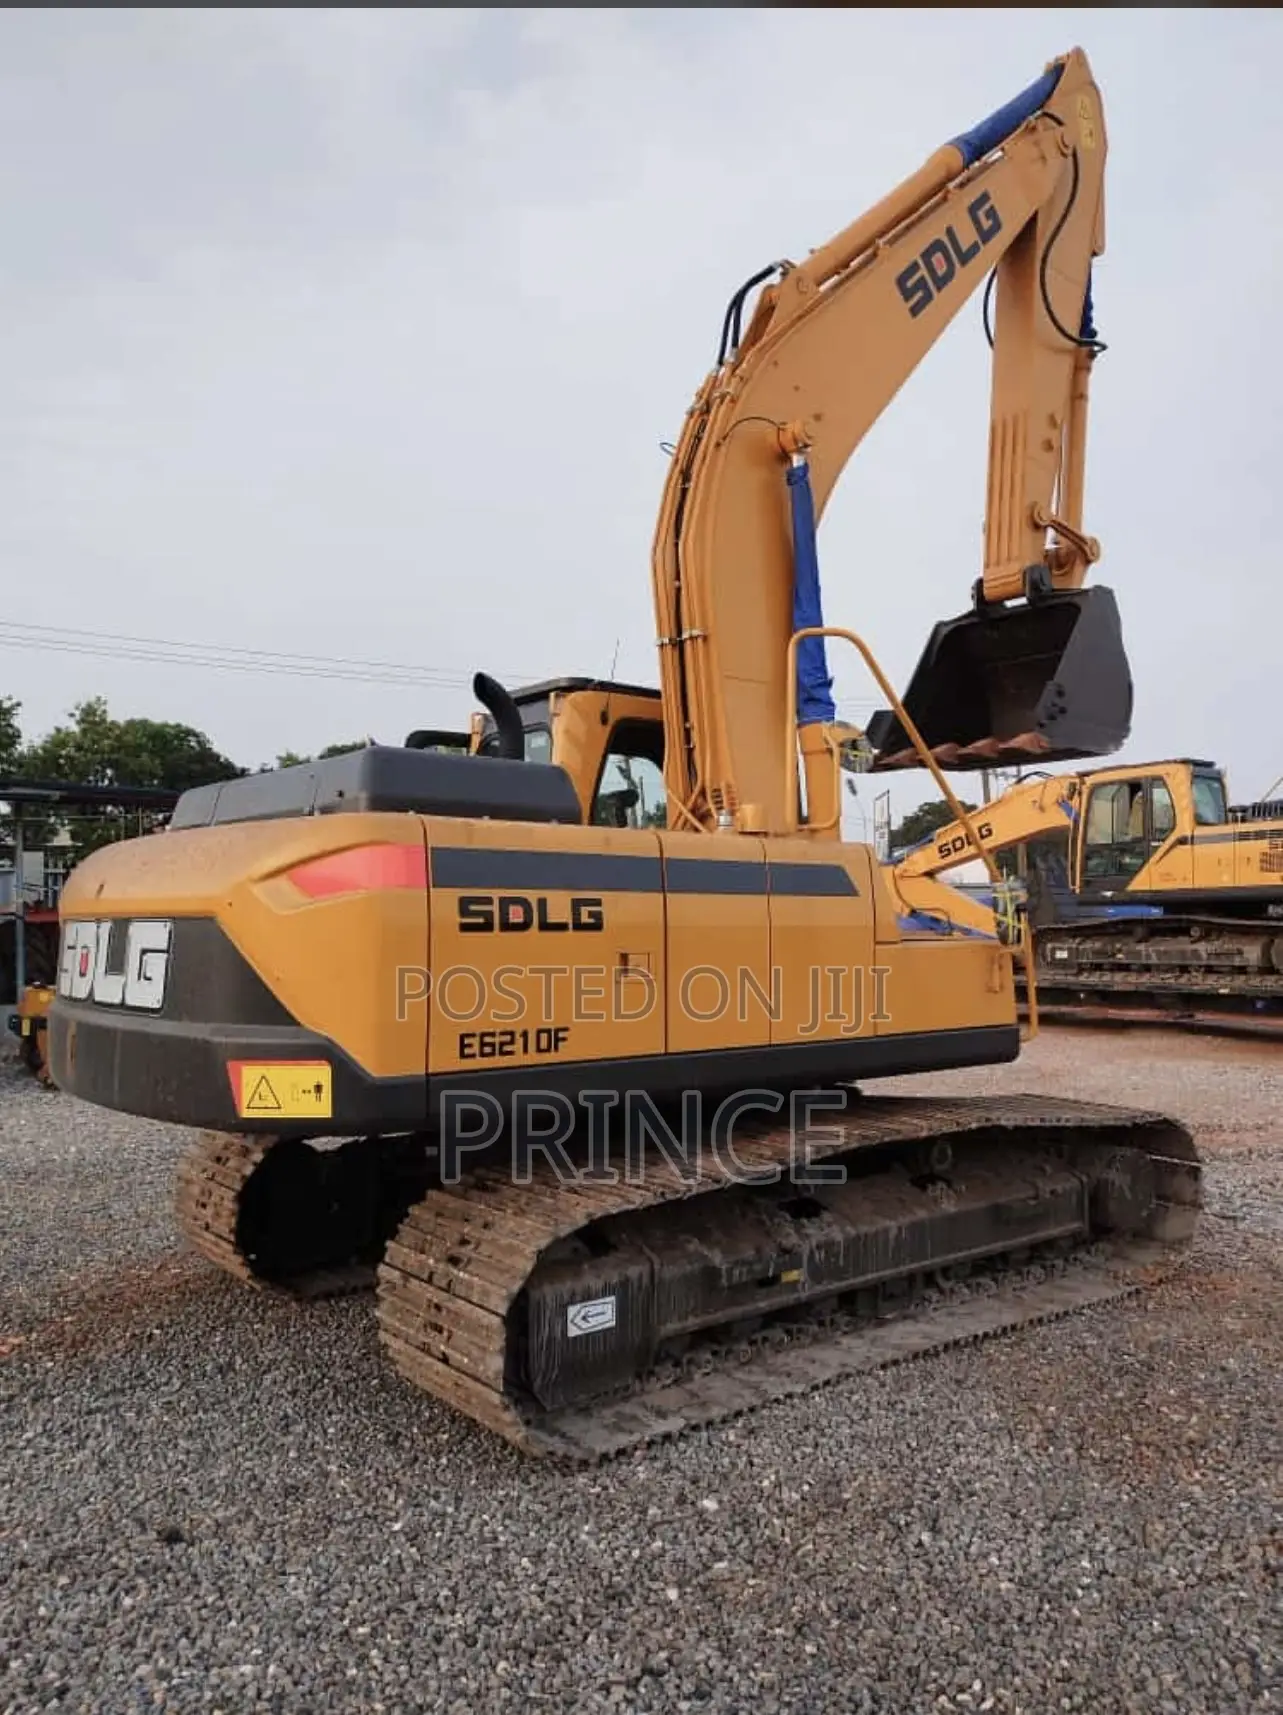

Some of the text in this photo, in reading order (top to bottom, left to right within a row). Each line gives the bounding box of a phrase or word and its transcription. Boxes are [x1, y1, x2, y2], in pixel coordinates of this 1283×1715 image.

[896, 190, 1002, 319] SDLG
[459, 896, 604, 932] SDLG
[60, 919, 172, 1010] SDLG
[459, 1027, 570, 1060] E6210F
